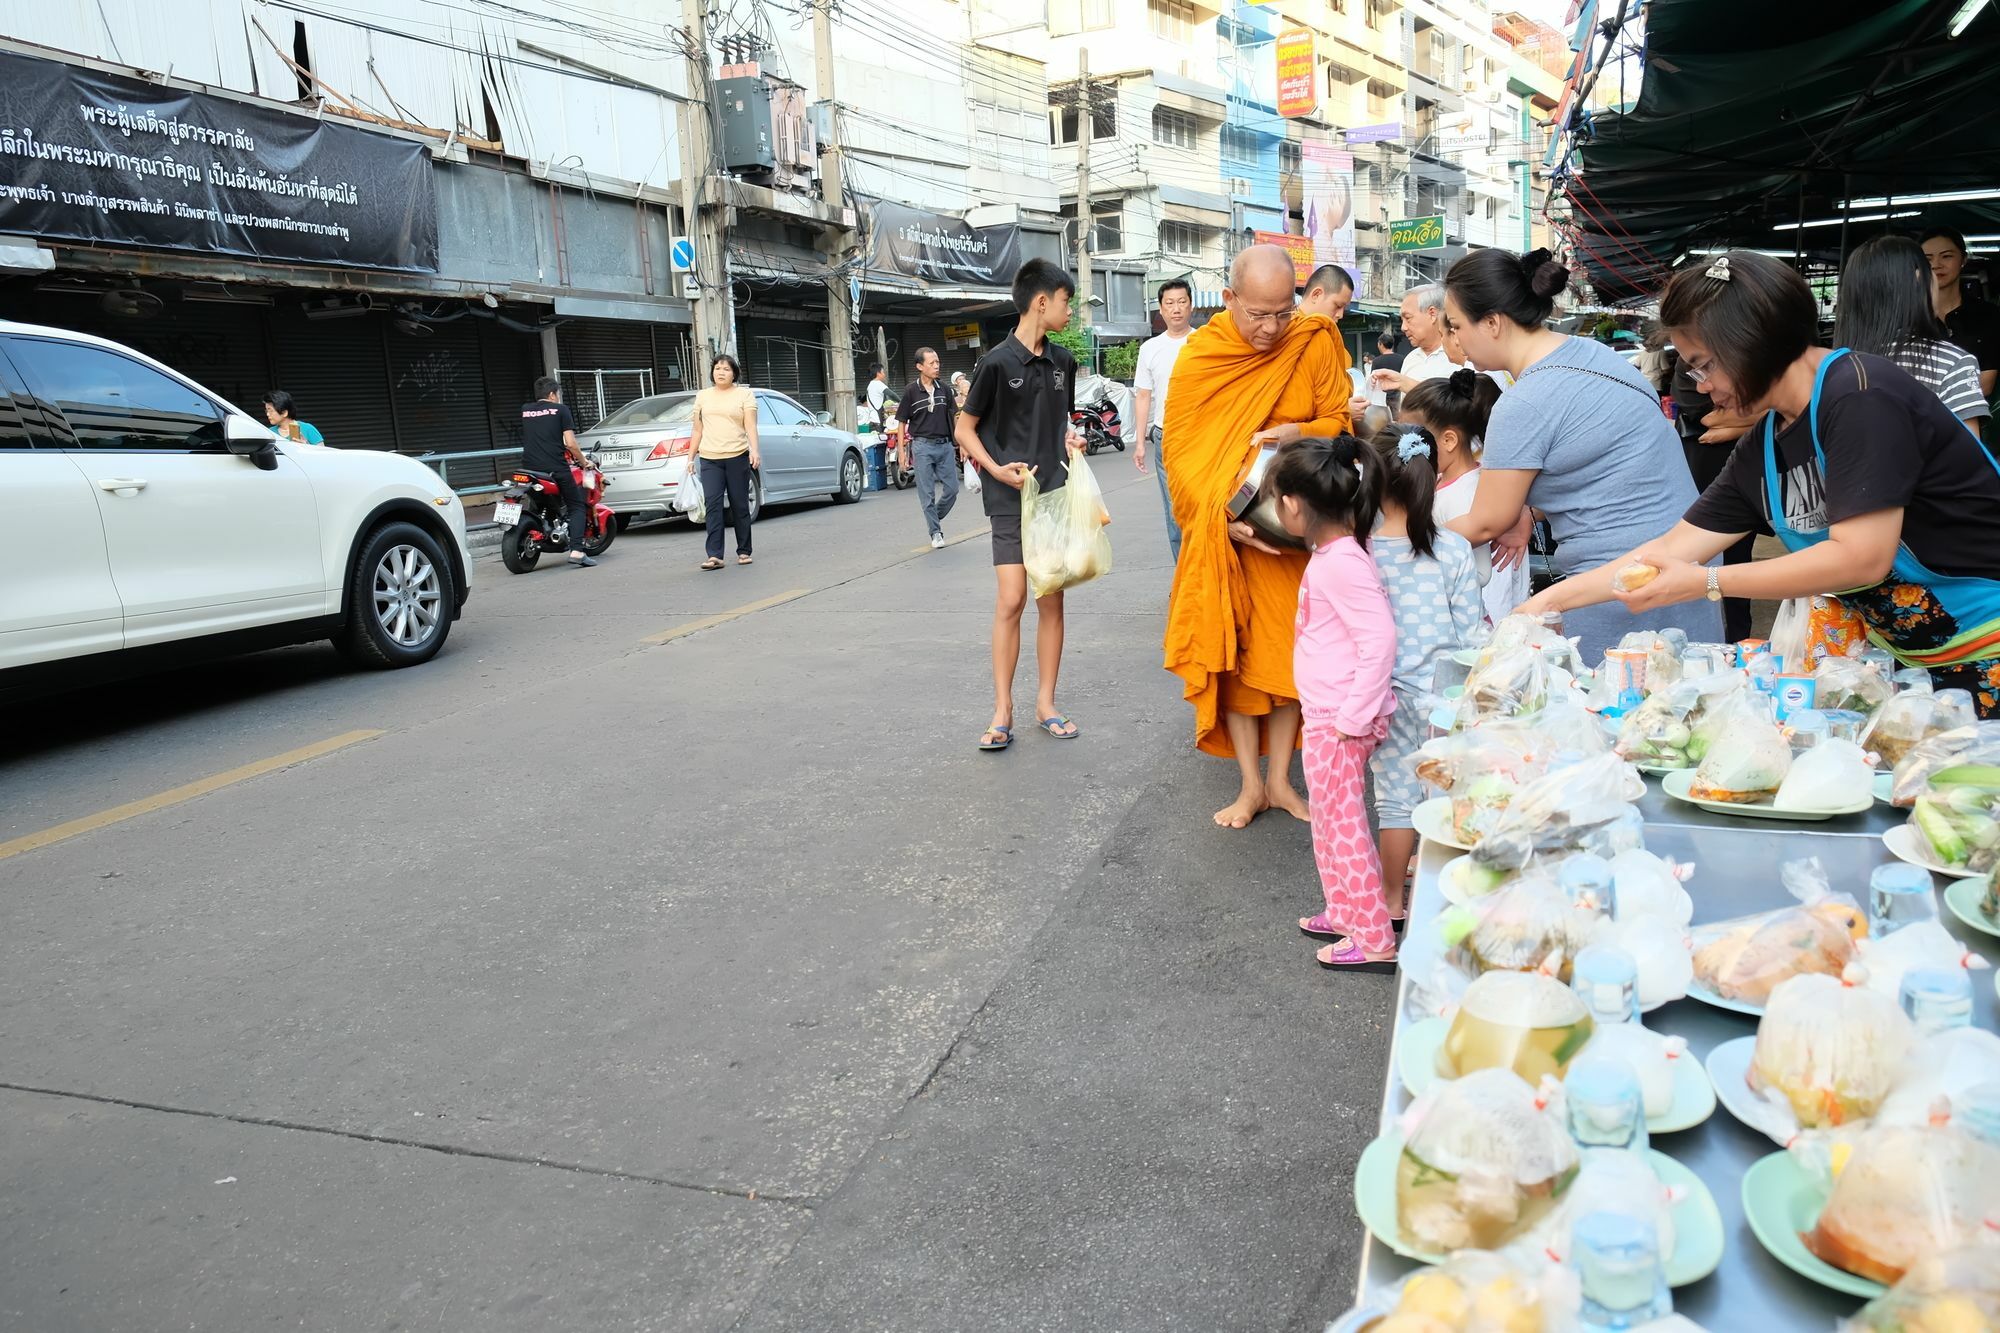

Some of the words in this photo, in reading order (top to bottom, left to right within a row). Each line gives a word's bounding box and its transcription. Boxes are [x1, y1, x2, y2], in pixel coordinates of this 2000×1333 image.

[80, 104, 255, 151] พระผู้เสด็จสู่สวรรคาลัย
[0, 128, 202, 187] ลึกในพระมหากรุณาธิคุณ
[208, 162, 358, 208] เป็นล้นพ้นอันหาที่สุดมิได้
